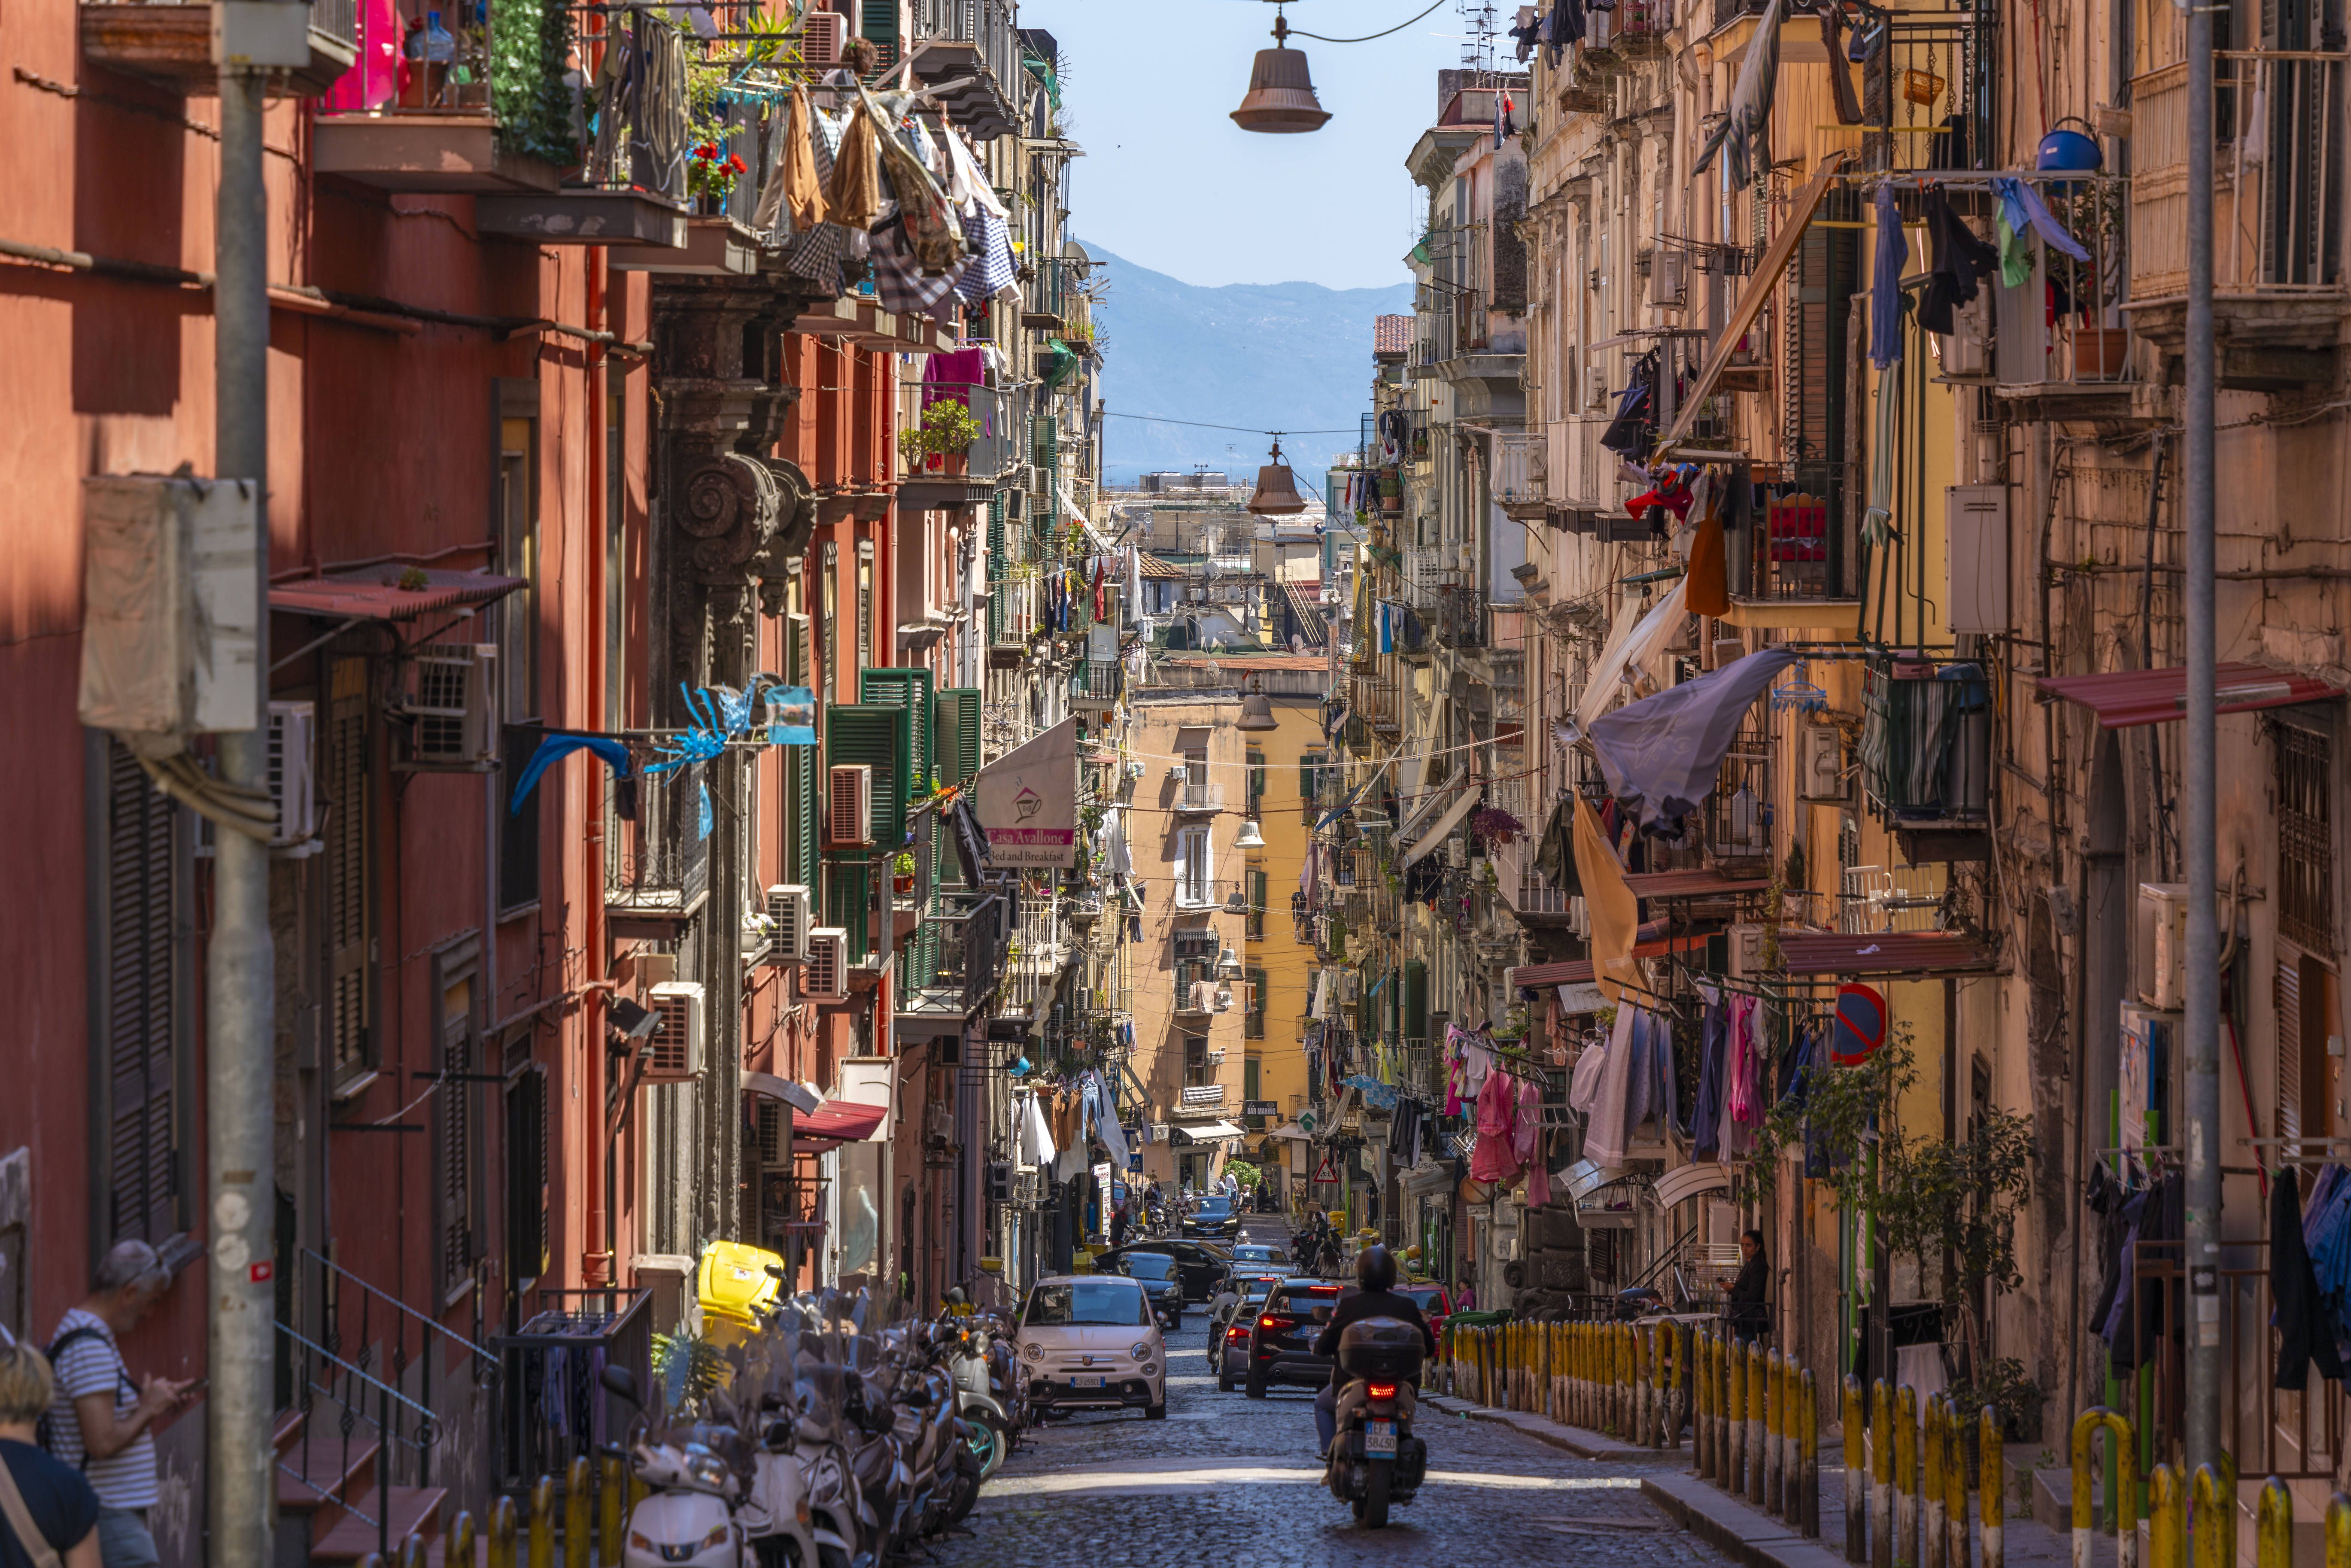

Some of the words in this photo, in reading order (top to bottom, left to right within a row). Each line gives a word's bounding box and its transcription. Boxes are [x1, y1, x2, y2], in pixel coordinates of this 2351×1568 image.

[987, 830, 1013, 843] Casa
[1016, 830, 1064, 844] Avallone
[990, 850, 1005, 860] Bed
[1007, 851, 1022, 861] and
[1025, 851, 1064, 861] Breakfast
[1367, 1436, 1395, 1449] 38430
